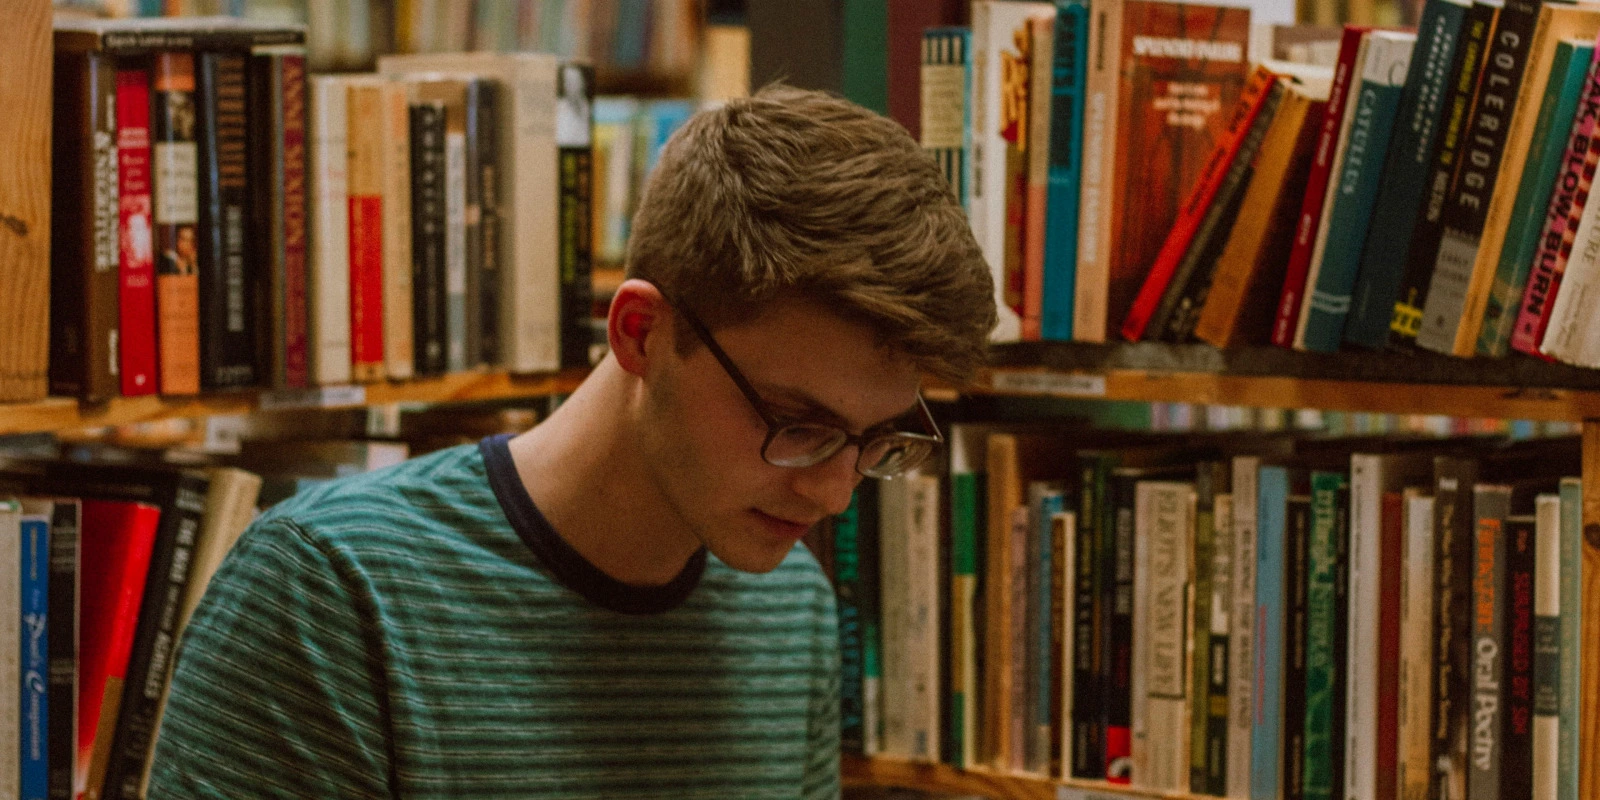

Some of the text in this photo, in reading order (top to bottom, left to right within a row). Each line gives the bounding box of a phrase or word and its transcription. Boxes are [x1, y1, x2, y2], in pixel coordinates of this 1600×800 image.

[1342, 88, 1376, 195] CATULLUS
[1458, 30, 1519, 211] COLERIDGE
[1552, 134, 1589, 225] BLOW,
[1526, 231, 1563, 315] BURN
[1474, 637, 1498, 689] Oral
[1471, 693, 1497, 771] Poetry
